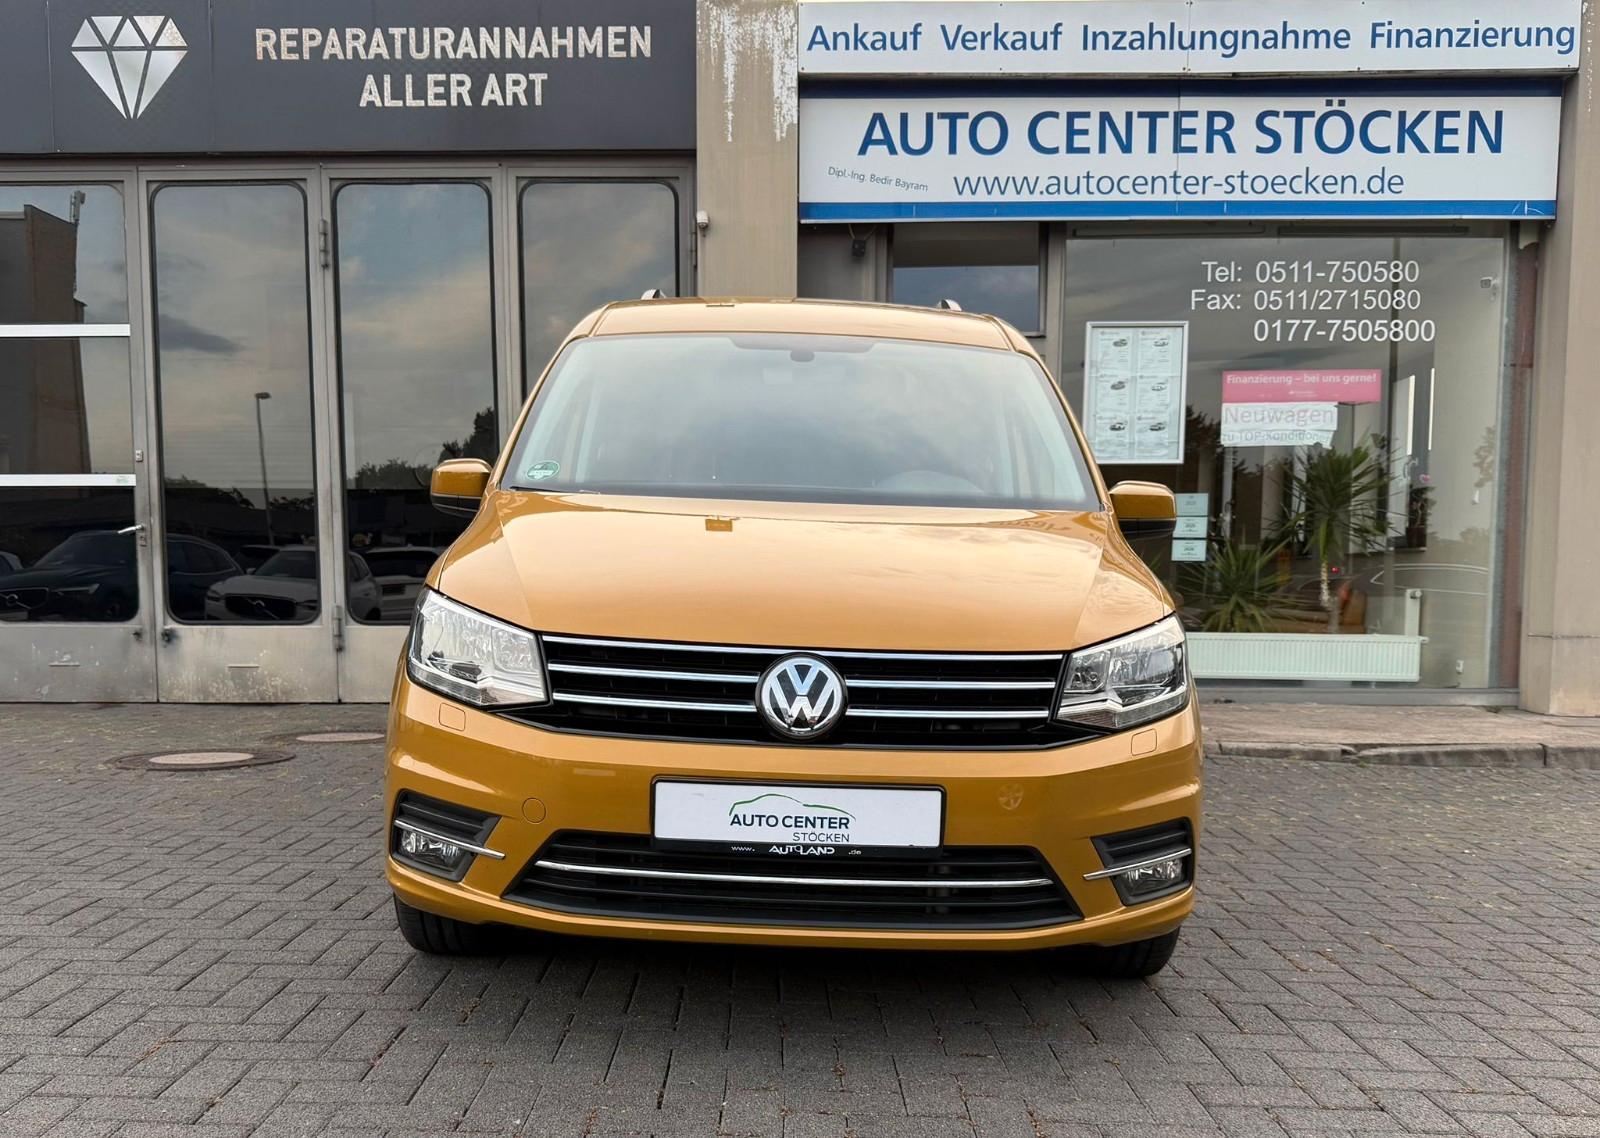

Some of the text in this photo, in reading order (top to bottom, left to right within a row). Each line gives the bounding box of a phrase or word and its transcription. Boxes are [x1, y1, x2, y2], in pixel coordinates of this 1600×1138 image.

[255, 25, 652, 60] REPARATURANNAHMEN
[806, 19, 1575, 58] Ankauf Verkauf Inzahlungnahme Finanzierung
[359, 71, 548, 108] ALLER ART
[857, 98, 1504, 156] AUTO CENTER STÖCKEN
[827, 166, 929, 192] Dipl.-Ing. Bedir Bayram
[953, 166, 1404, 196] www.autocenter-stoecken.de
[1202, 260, 1420, 283] Tel: 0511-750580
[1190, 288, 1421, 311] Fax: 0511/2715080
[1253, 319, 1436, 342] 0177-7505800
[1226, 373, 1293, 386] Finanzierung
[1303, 373, 1320, 383] bei
[1322, 374, 1341, 383] uns
[1342, 373, 1377, 385] gerne!
[1224, 406, 1335, 427] Neuwagen
[729, 813, 850, 830] AUTO CENTER
[792, 831, 850, 843] STÖCKEN
[768, 844, 835, 856] AUTOLAND
